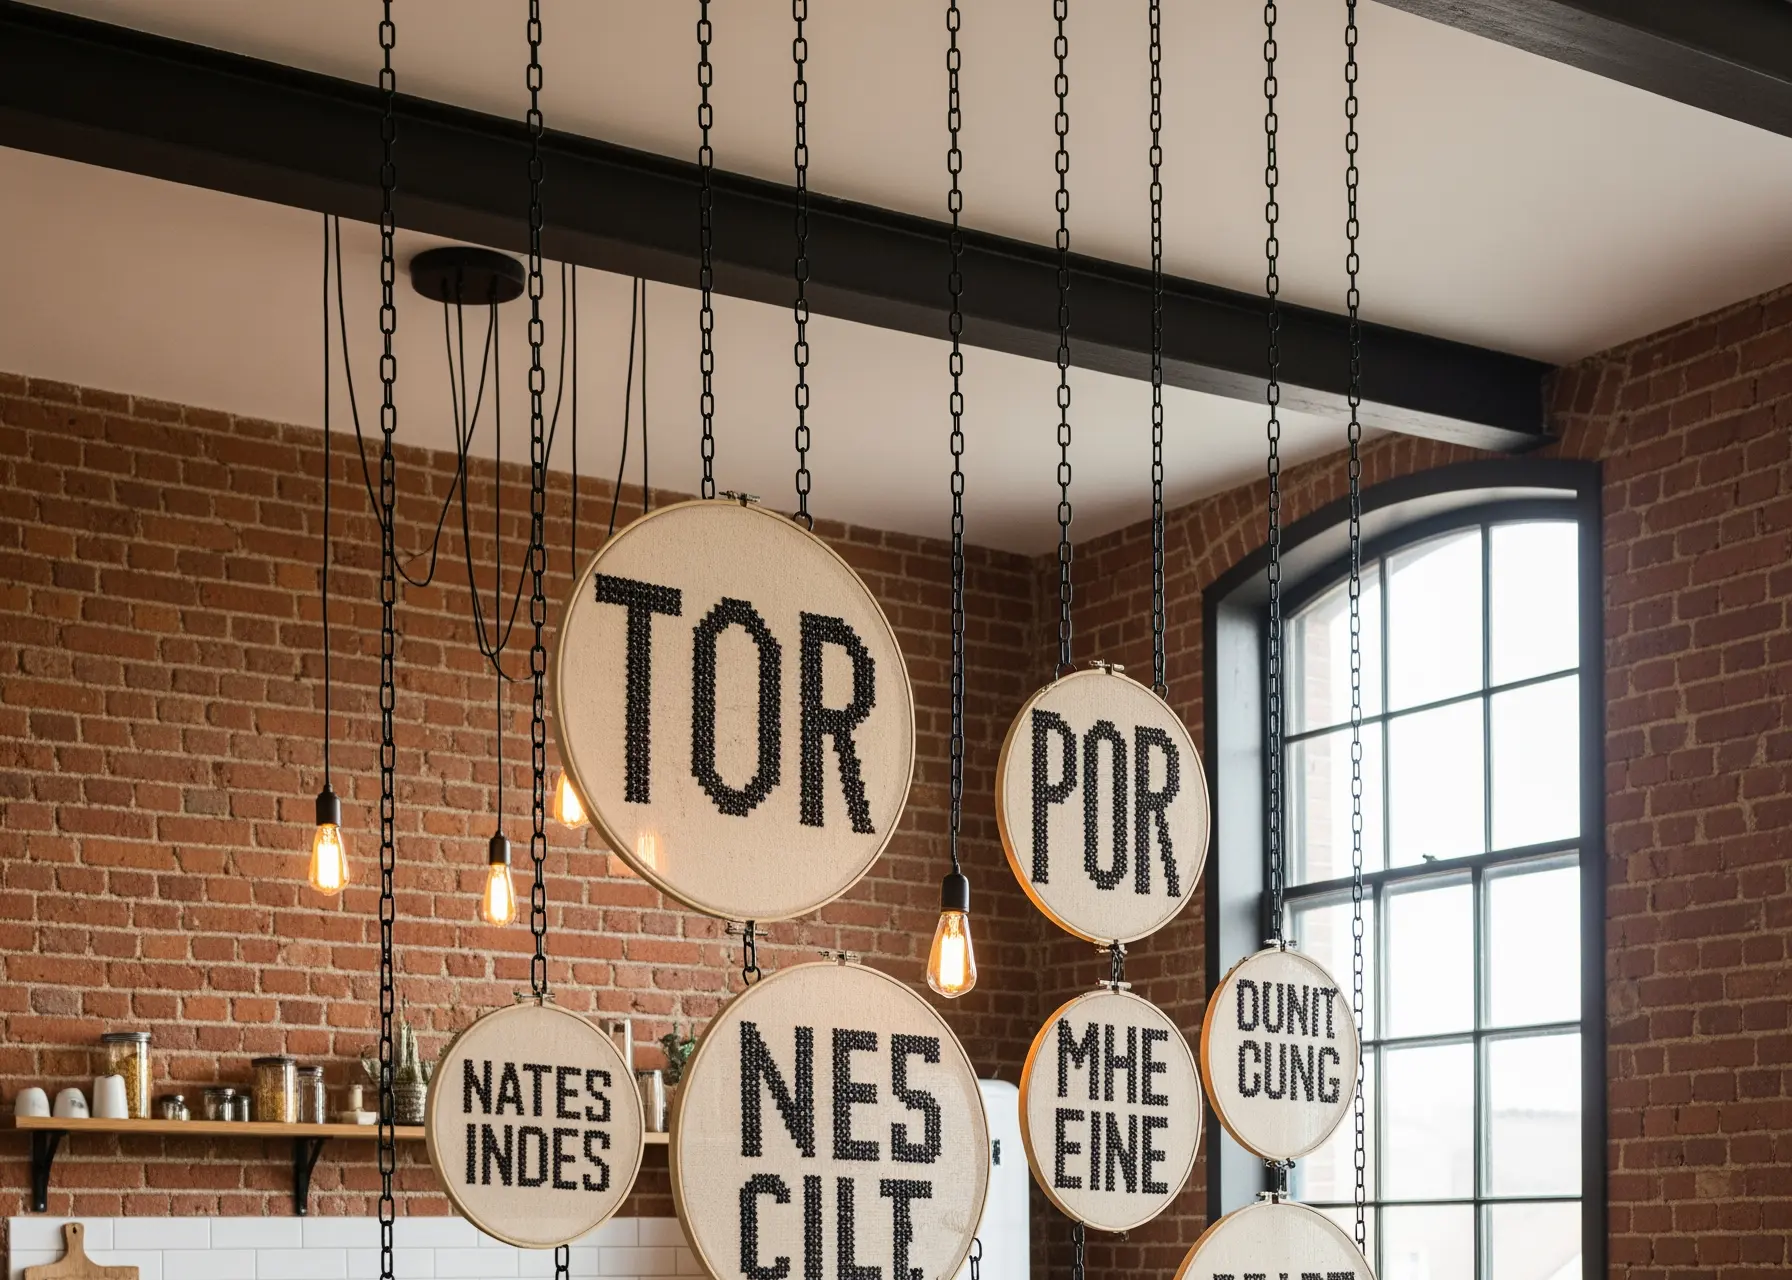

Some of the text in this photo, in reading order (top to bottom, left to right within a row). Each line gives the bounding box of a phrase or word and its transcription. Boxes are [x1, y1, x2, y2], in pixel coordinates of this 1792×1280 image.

[595, 572, 876, 835] TOR
[1031, 708, 1181, 898] POR
[463, 1058, 611, 1123] NATES
[740, 1020, 942, 1165] NES
[1057, 1017, 1170, 1107] MHE
[1238, 1039, 1341, 1104] CUNG
[466, 1122, 611, 1193] INDES
[1054, 1107, 1169, 1195] EINE
